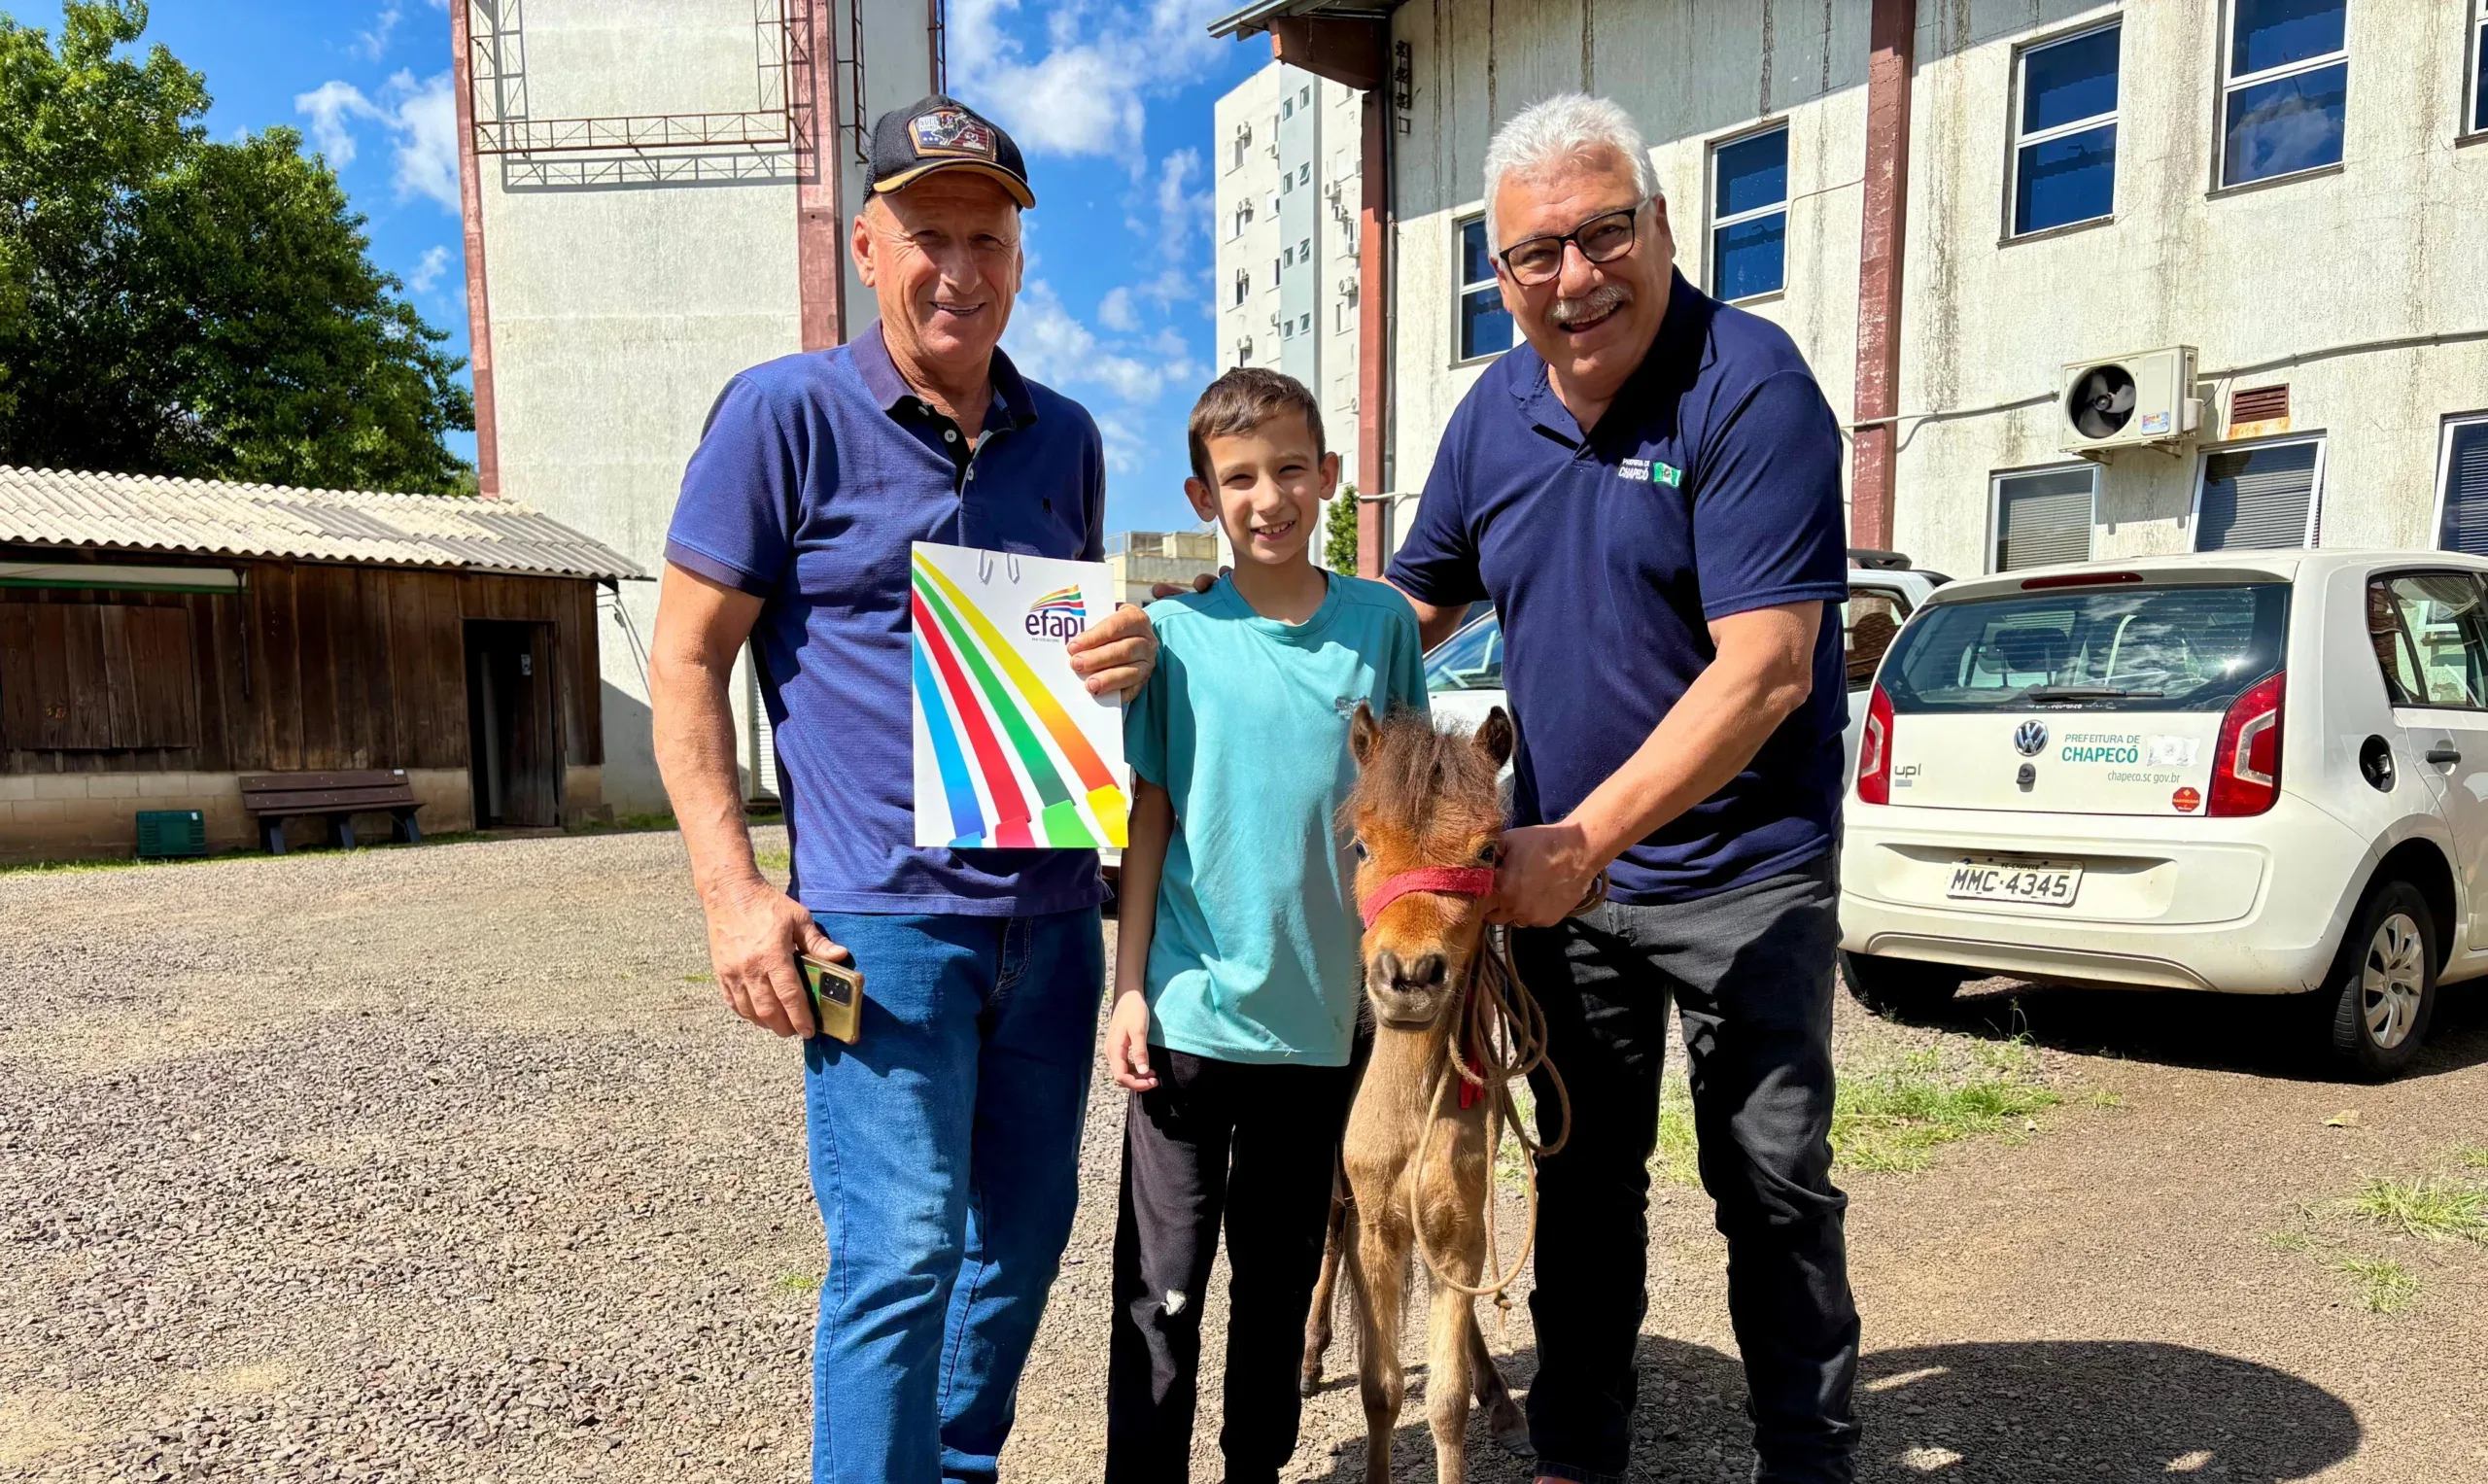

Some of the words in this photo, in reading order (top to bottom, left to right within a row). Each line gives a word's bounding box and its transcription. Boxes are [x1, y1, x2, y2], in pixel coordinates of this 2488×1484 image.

[1618, 466, 1649, 481] CHAPECÓ
[2064, 734, 2124, 743] PREFEITURA
[2126, 734, 2141, 744] DE
[2061, 744, 2139, 764] CHAPECÓ
